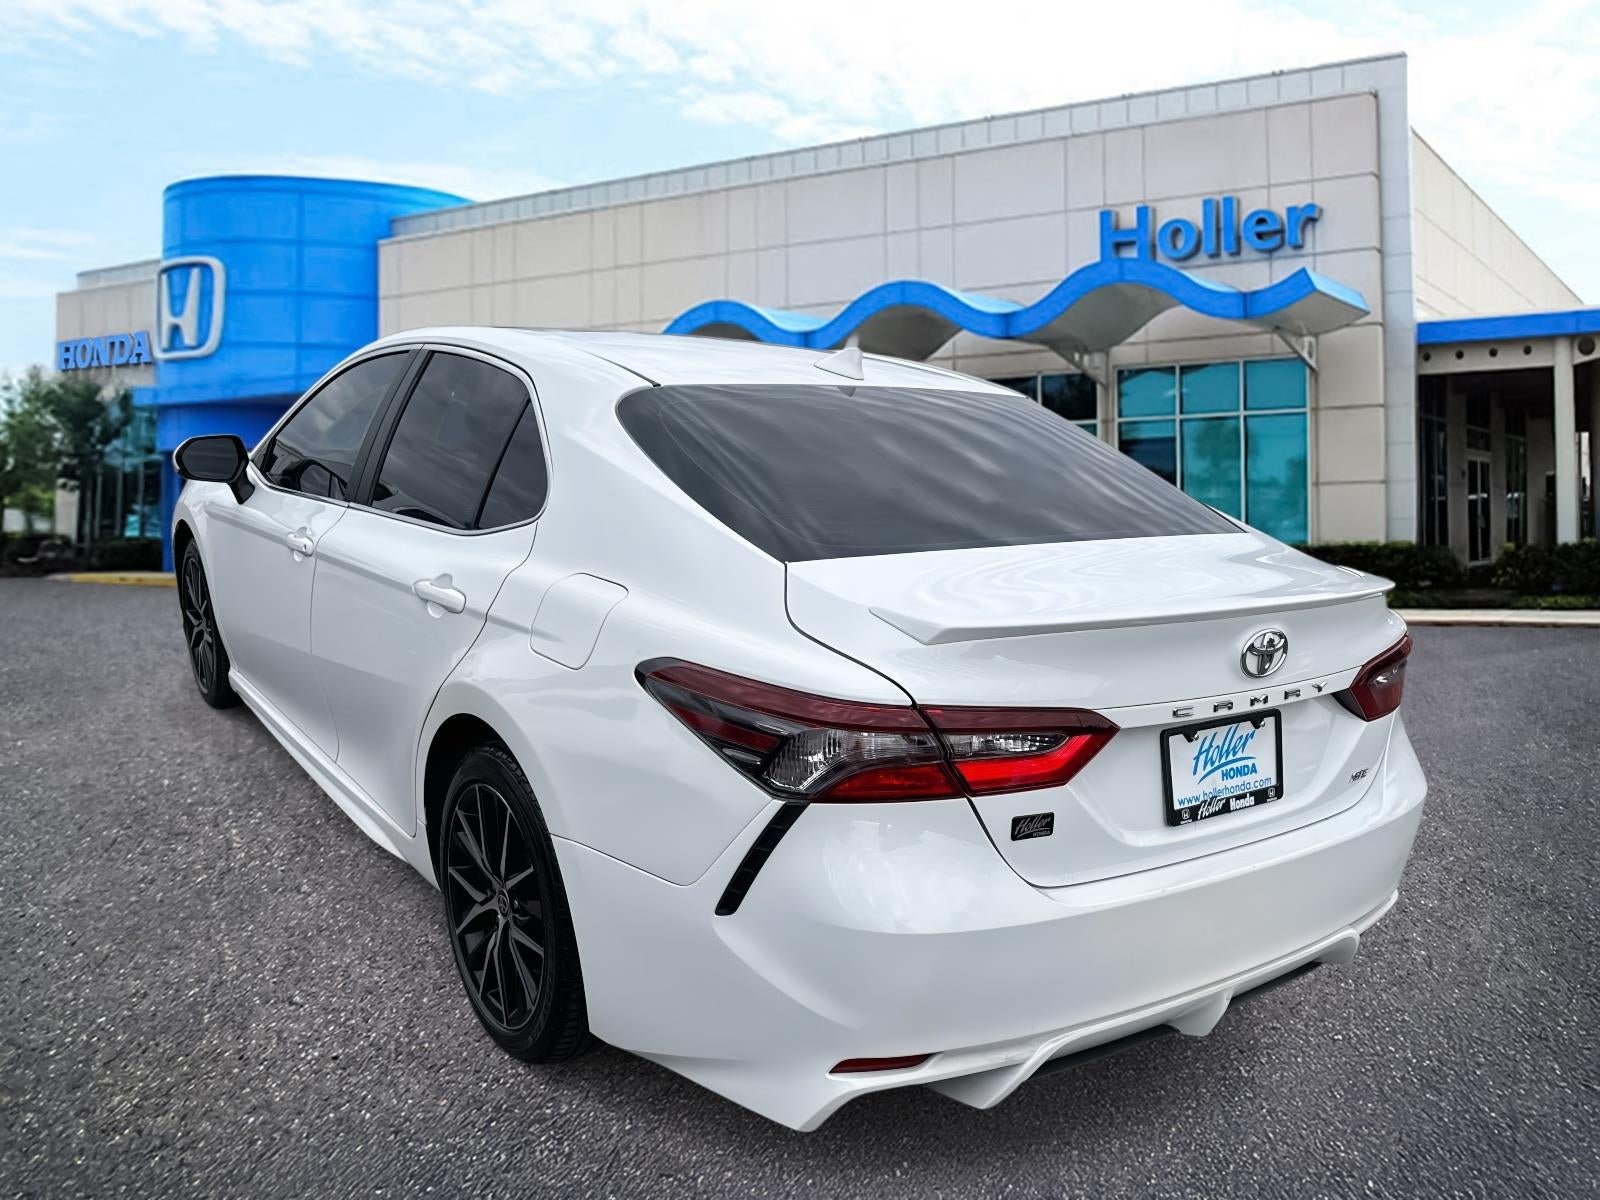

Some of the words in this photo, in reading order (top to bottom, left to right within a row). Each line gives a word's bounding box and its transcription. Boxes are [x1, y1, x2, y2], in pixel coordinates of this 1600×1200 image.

[1099, 196, 1321, 263] Holler
[57, 331, 152, 370] HONDA
[1172, 681, 1328, 718] CAMRY
[1193, 723, 1256, 776] Holler
[1221, 762, 1258, 781] HONDA
[1177, 777, 1272, 807] www.hollerhonda.com
[1197, 797, 1227, 821] Holler
[1229, 793, 1255, 811] Honda
[1015, 814, 1052, 835] Holler
